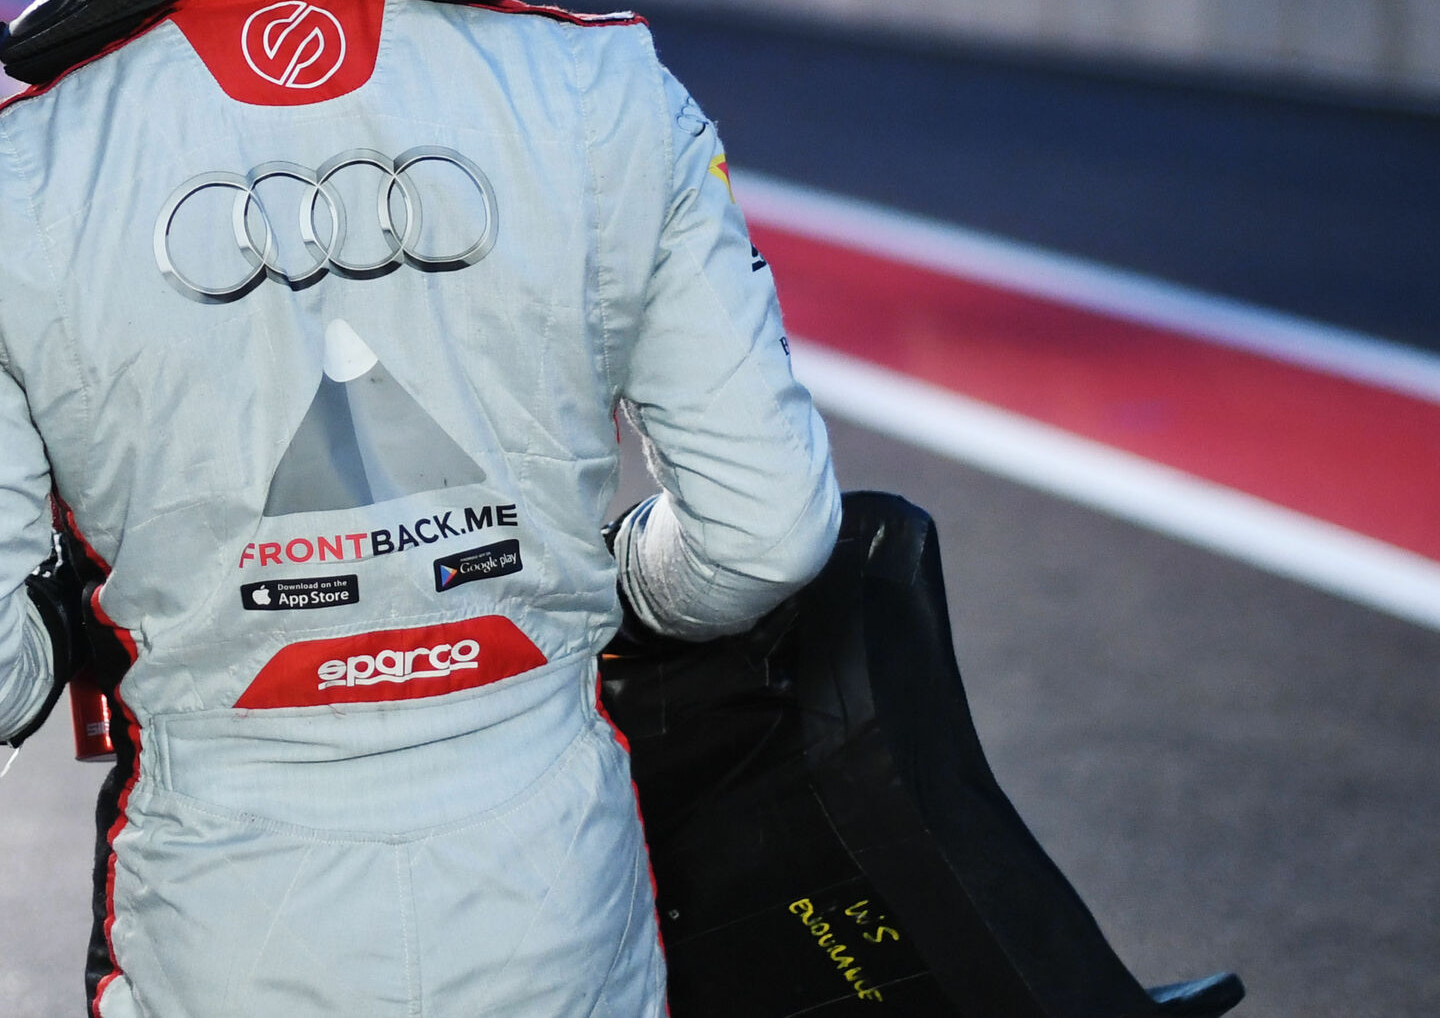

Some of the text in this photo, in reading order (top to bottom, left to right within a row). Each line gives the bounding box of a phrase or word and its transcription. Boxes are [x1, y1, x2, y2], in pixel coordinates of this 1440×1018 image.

[239, 504, 519, 569] FRONTBACK.ME
[460, 556, 498, 574] Google
[499, 552, 517, 568] play
[277, 582, 319, 591] Download
[334, 579, 348, 587] the
[279, 590, 350, 607] App Store
[317, 638, 480, 689] sparco
